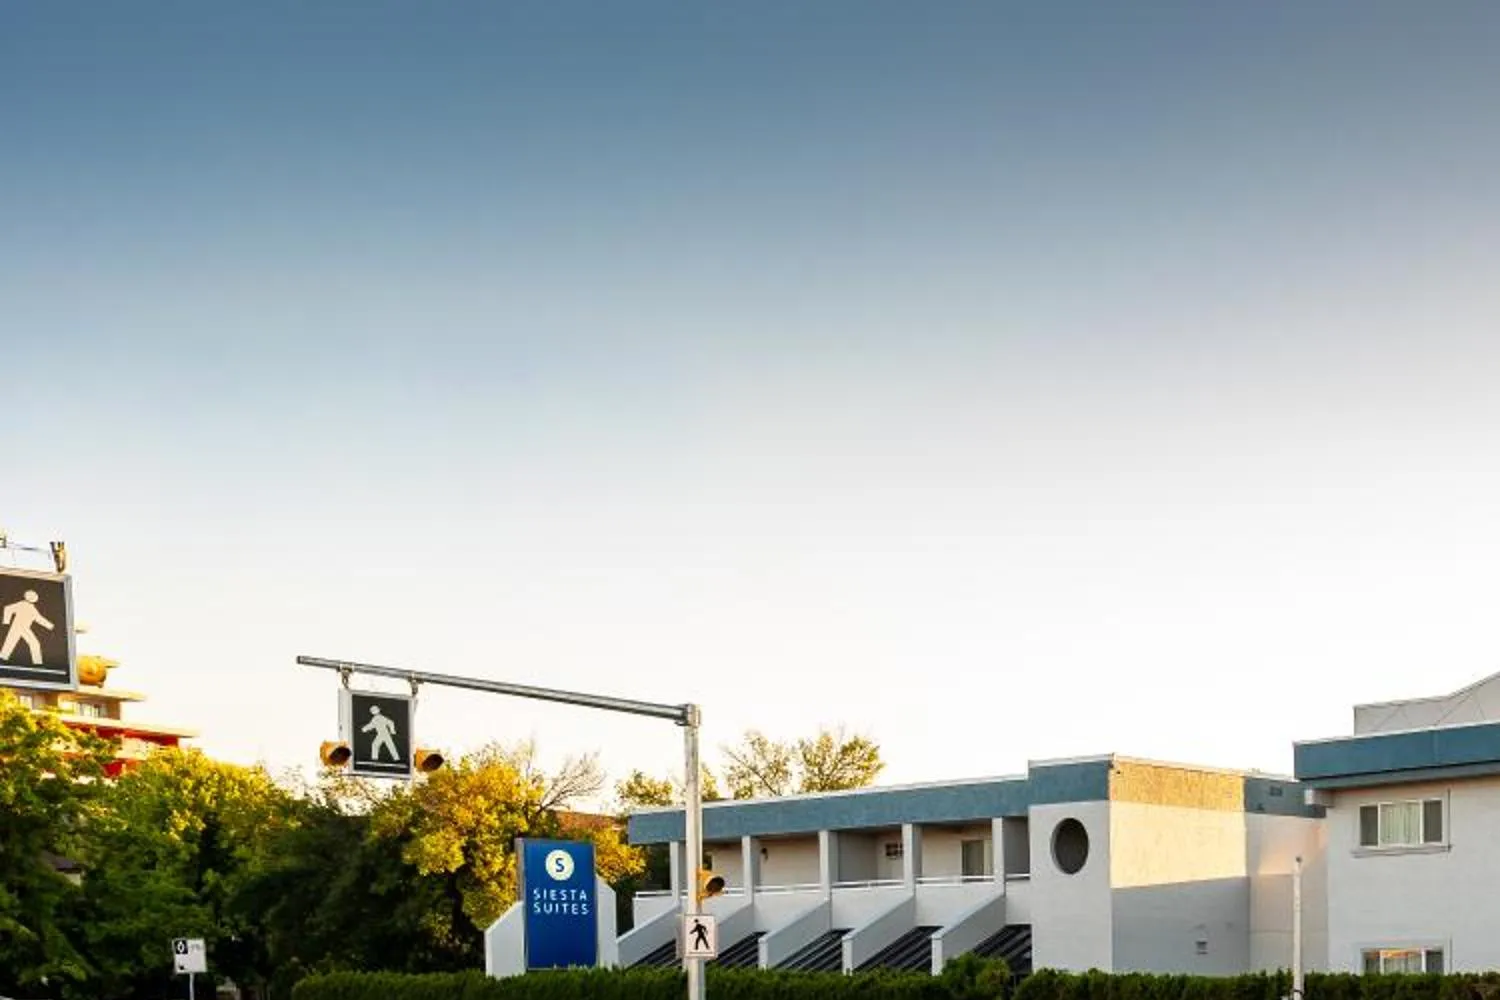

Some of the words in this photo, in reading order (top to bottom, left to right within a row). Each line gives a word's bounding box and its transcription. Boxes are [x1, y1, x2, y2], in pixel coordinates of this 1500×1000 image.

[555, 858, 565, 872] S
[533, 888, 587, 900] SIESTA
[533, 902, 589, 915] SUITES
